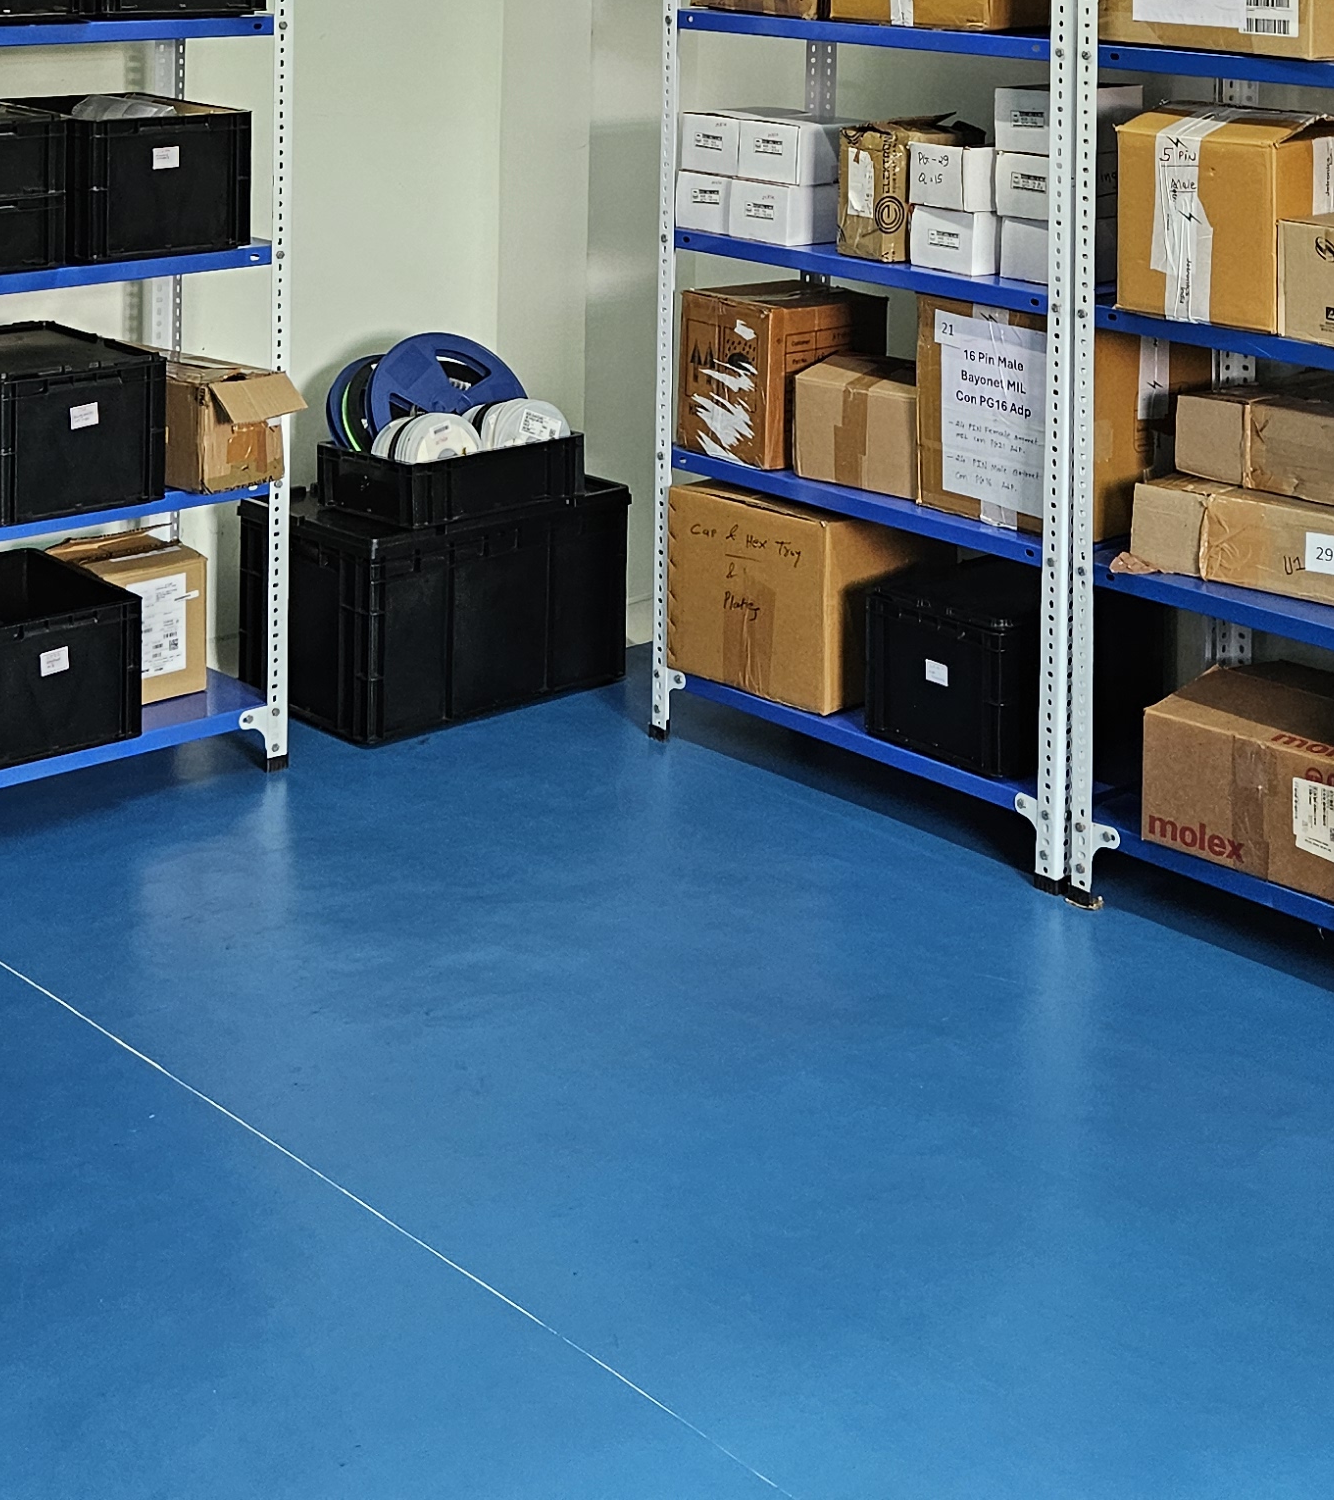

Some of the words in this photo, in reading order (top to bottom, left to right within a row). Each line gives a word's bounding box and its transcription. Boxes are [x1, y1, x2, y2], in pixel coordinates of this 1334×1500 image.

[1159, 147, 1174, 161] 5
[941, 322, 954, 336] 21
[963, 349, 976, 362] 16
[978, 352, 995, 366] Pin
[998, 356, 1024, 372] Male
[961, 370, 1005, 390] Bayonet
[1007, 379, 1027, 395] MIL
[956, 390, 977, 406] Con
[980, 395, 1008, 412] PG16
[1010, 402, 1032, 419] Adp
[1316, 546, 1334, 563] 29
[1149, 814, 1245, 864] molex
